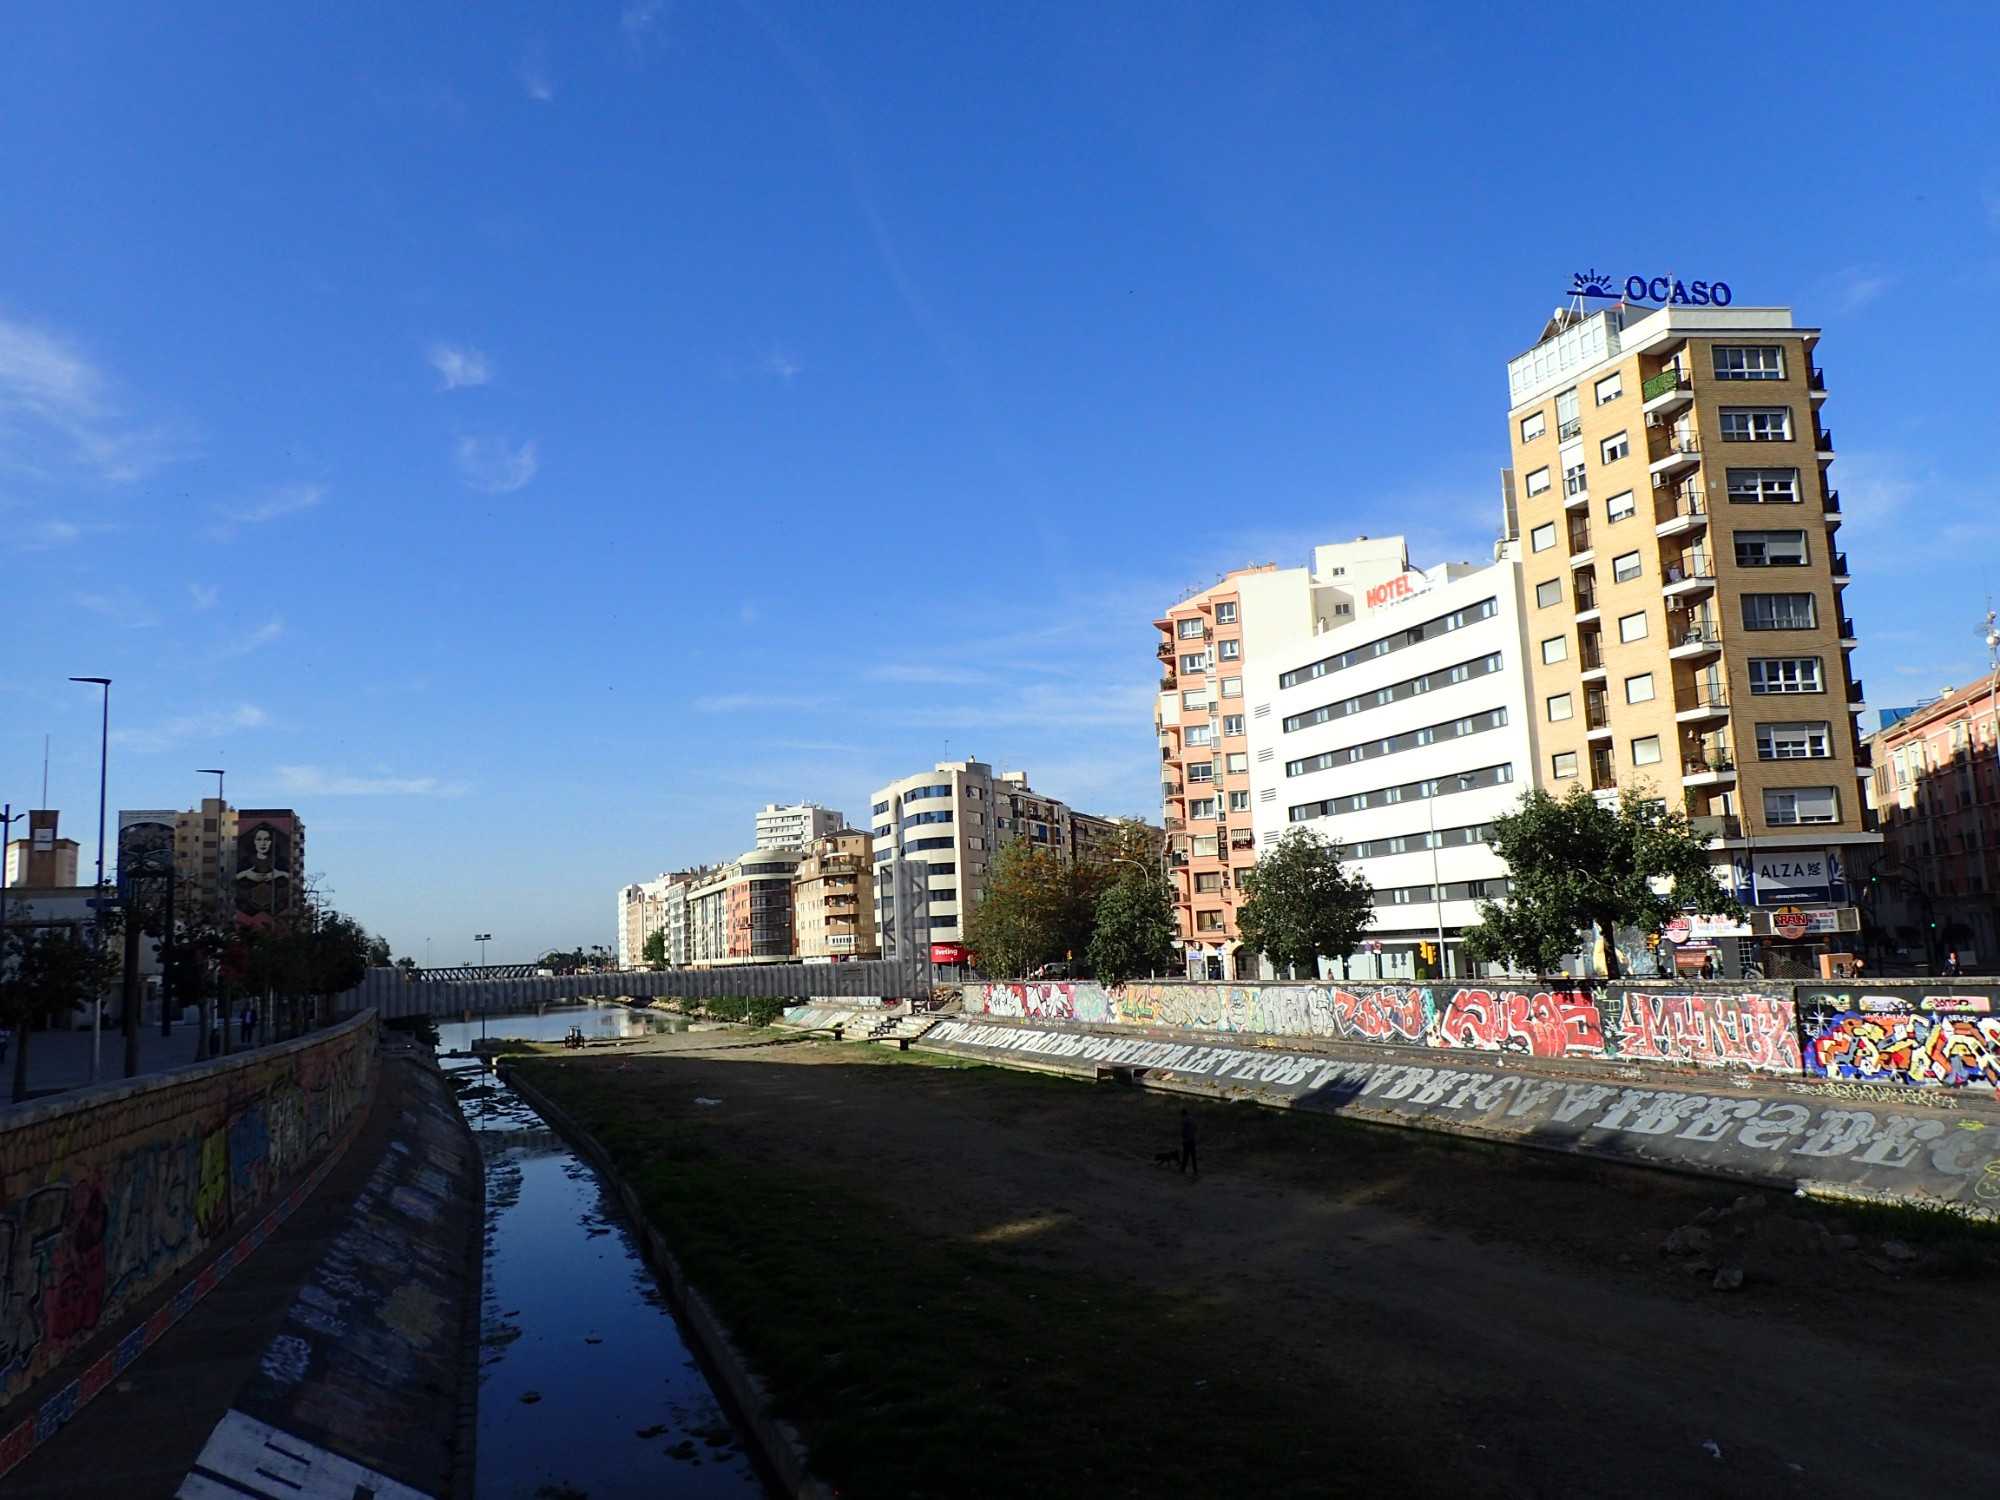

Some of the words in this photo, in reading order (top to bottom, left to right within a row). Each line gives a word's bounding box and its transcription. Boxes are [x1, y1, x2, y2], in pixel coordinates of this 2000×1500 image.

[1626, 276, 1731, 306] OCASO
[1367, 575, 1413, 608] HOTEL
[1761, 864, 1804, 878] ALZA
